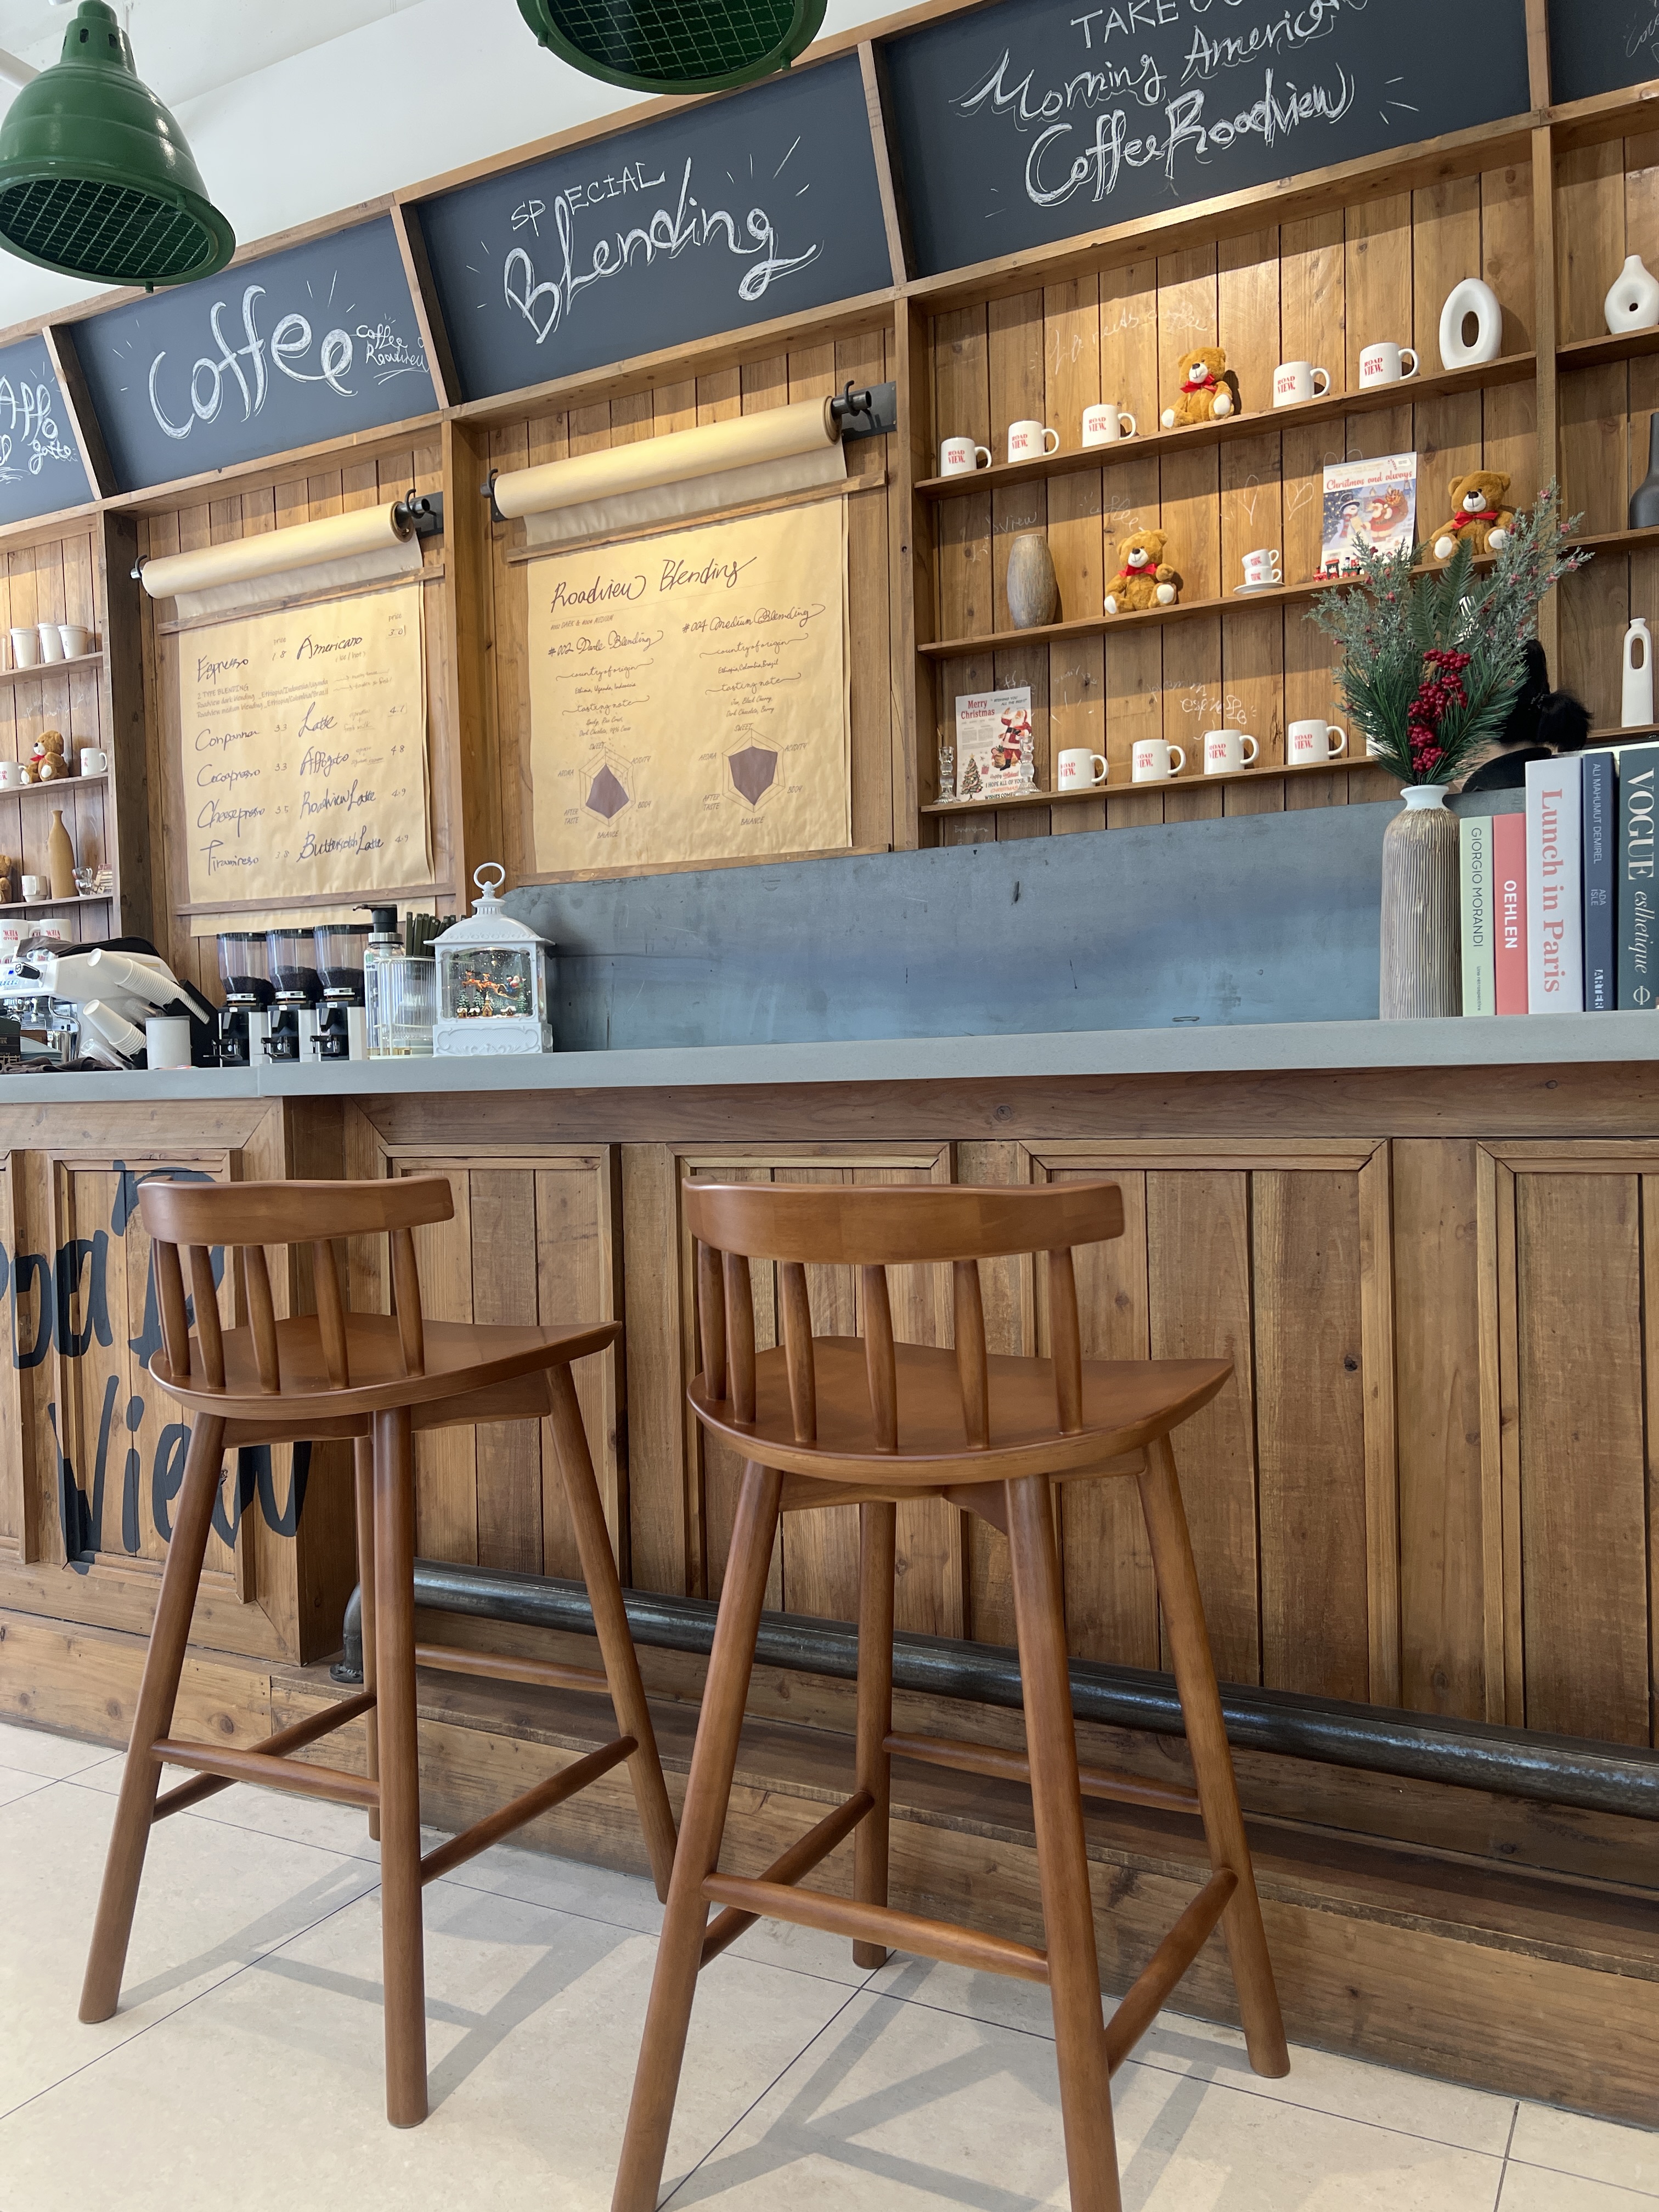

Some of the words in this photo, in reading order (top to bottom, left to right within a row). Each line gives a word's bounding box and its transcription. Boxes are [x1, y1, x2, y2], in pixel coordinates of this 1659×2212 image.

[955, 48, 1166, 124] Morning
[1026, 110, 1164, 204] Coffee
[510, 161, 665, 236] SPECIAL
[504, 157, 819, 345] Blending
[150, 285, 356, 439] Coffee
[1364, 357, 1383, 367] ROAD
[1278, 376, 1295, 385] ROAD
[1327, 477, 1364, 490] Christmas
[1368, 472, 1383, 483] and
[1386, 470, 1412, 481] always
[550, 575, 647, 613] Roadview
[659, 556, 757, 592] Blending
[297, 634, 362, 660] Americano
[202, 690, 216, 698] TYPE
[217, 684, 249, 695] BLENDING
[968, 700, 988, 709] Merry
[298, 701, 338, 737] Latte
[961, 709, 995, 720] Christmas
[734, 723, 754, 732] SWEET
[589, 741, 606, 751] SWEET
[785, 743, 808, 752] ACIDITY
[1593, 763, 1601, 777] ALI
[392, 788, 406, 798] 4.9
[787, 785, 803, 794] BODY
[637, 800, 652, 809] BODY
[703, 793, 720, 802] AFTER
[703, 802, 720, 811] TASTE
[565, 816, 579, 825] TASTE
[741, 816, 765, 825] BALANCE
[1628, 768, 1655, 881] VOGUE
[394, 834, 409, 843] 4.9
[597, 830, 619, 839] BALANCE
[1541, 789, 1564, 877] Lunch
[1594, 826, 1603, 864] DEMIREL
[1471, 827, 1482, 884] GIORGIO
[1543, 885, 1565, 912] in
[1472, 887, 1483, 947] MORANDI
[1504, 881, 1517, 949] OEHLEN
[1543, 919, 1566, 992] Paris
